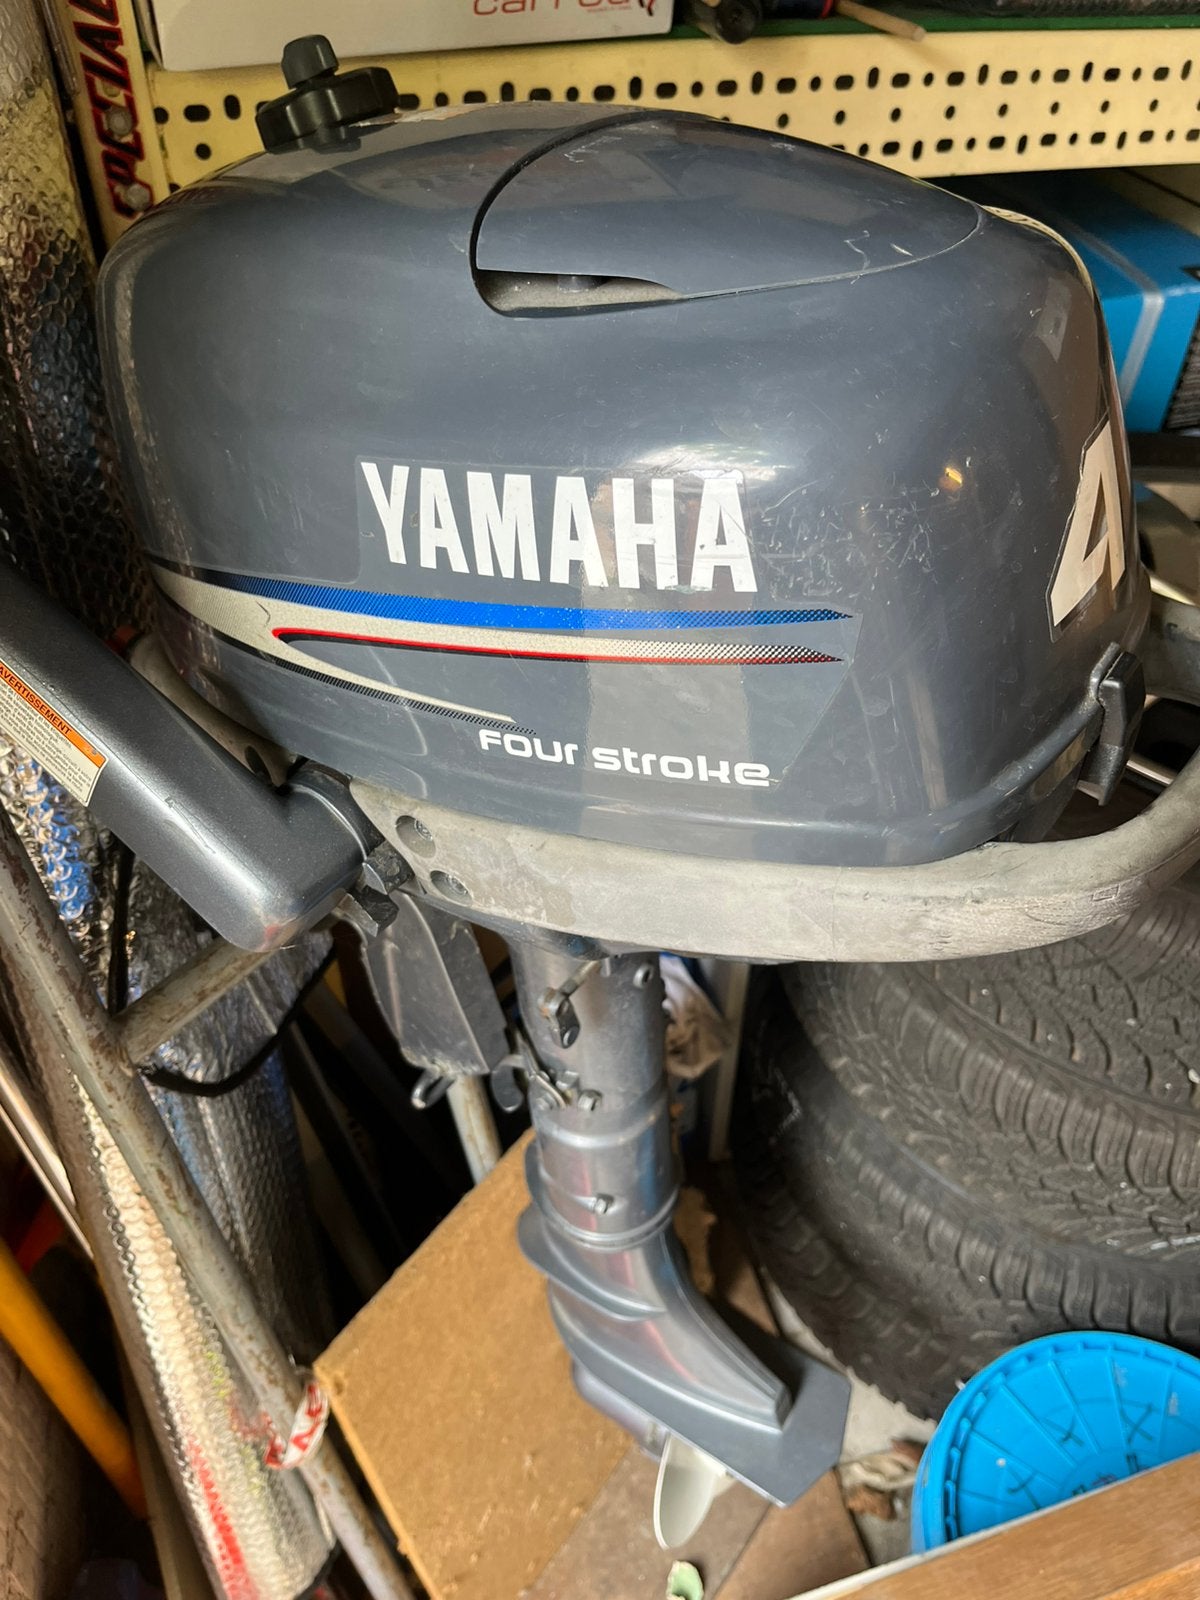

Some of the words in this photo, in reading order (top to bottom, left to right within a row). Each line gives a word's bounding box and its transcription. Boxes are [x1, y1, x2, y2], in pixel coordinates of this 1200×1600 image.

[360, 461, 758, 593] YAMAHA
[1050, 419, 1126, 628] 4
[0, 666, 71, 735] AVERTISSEMENT
[591, 746, 771, 787] stroke
